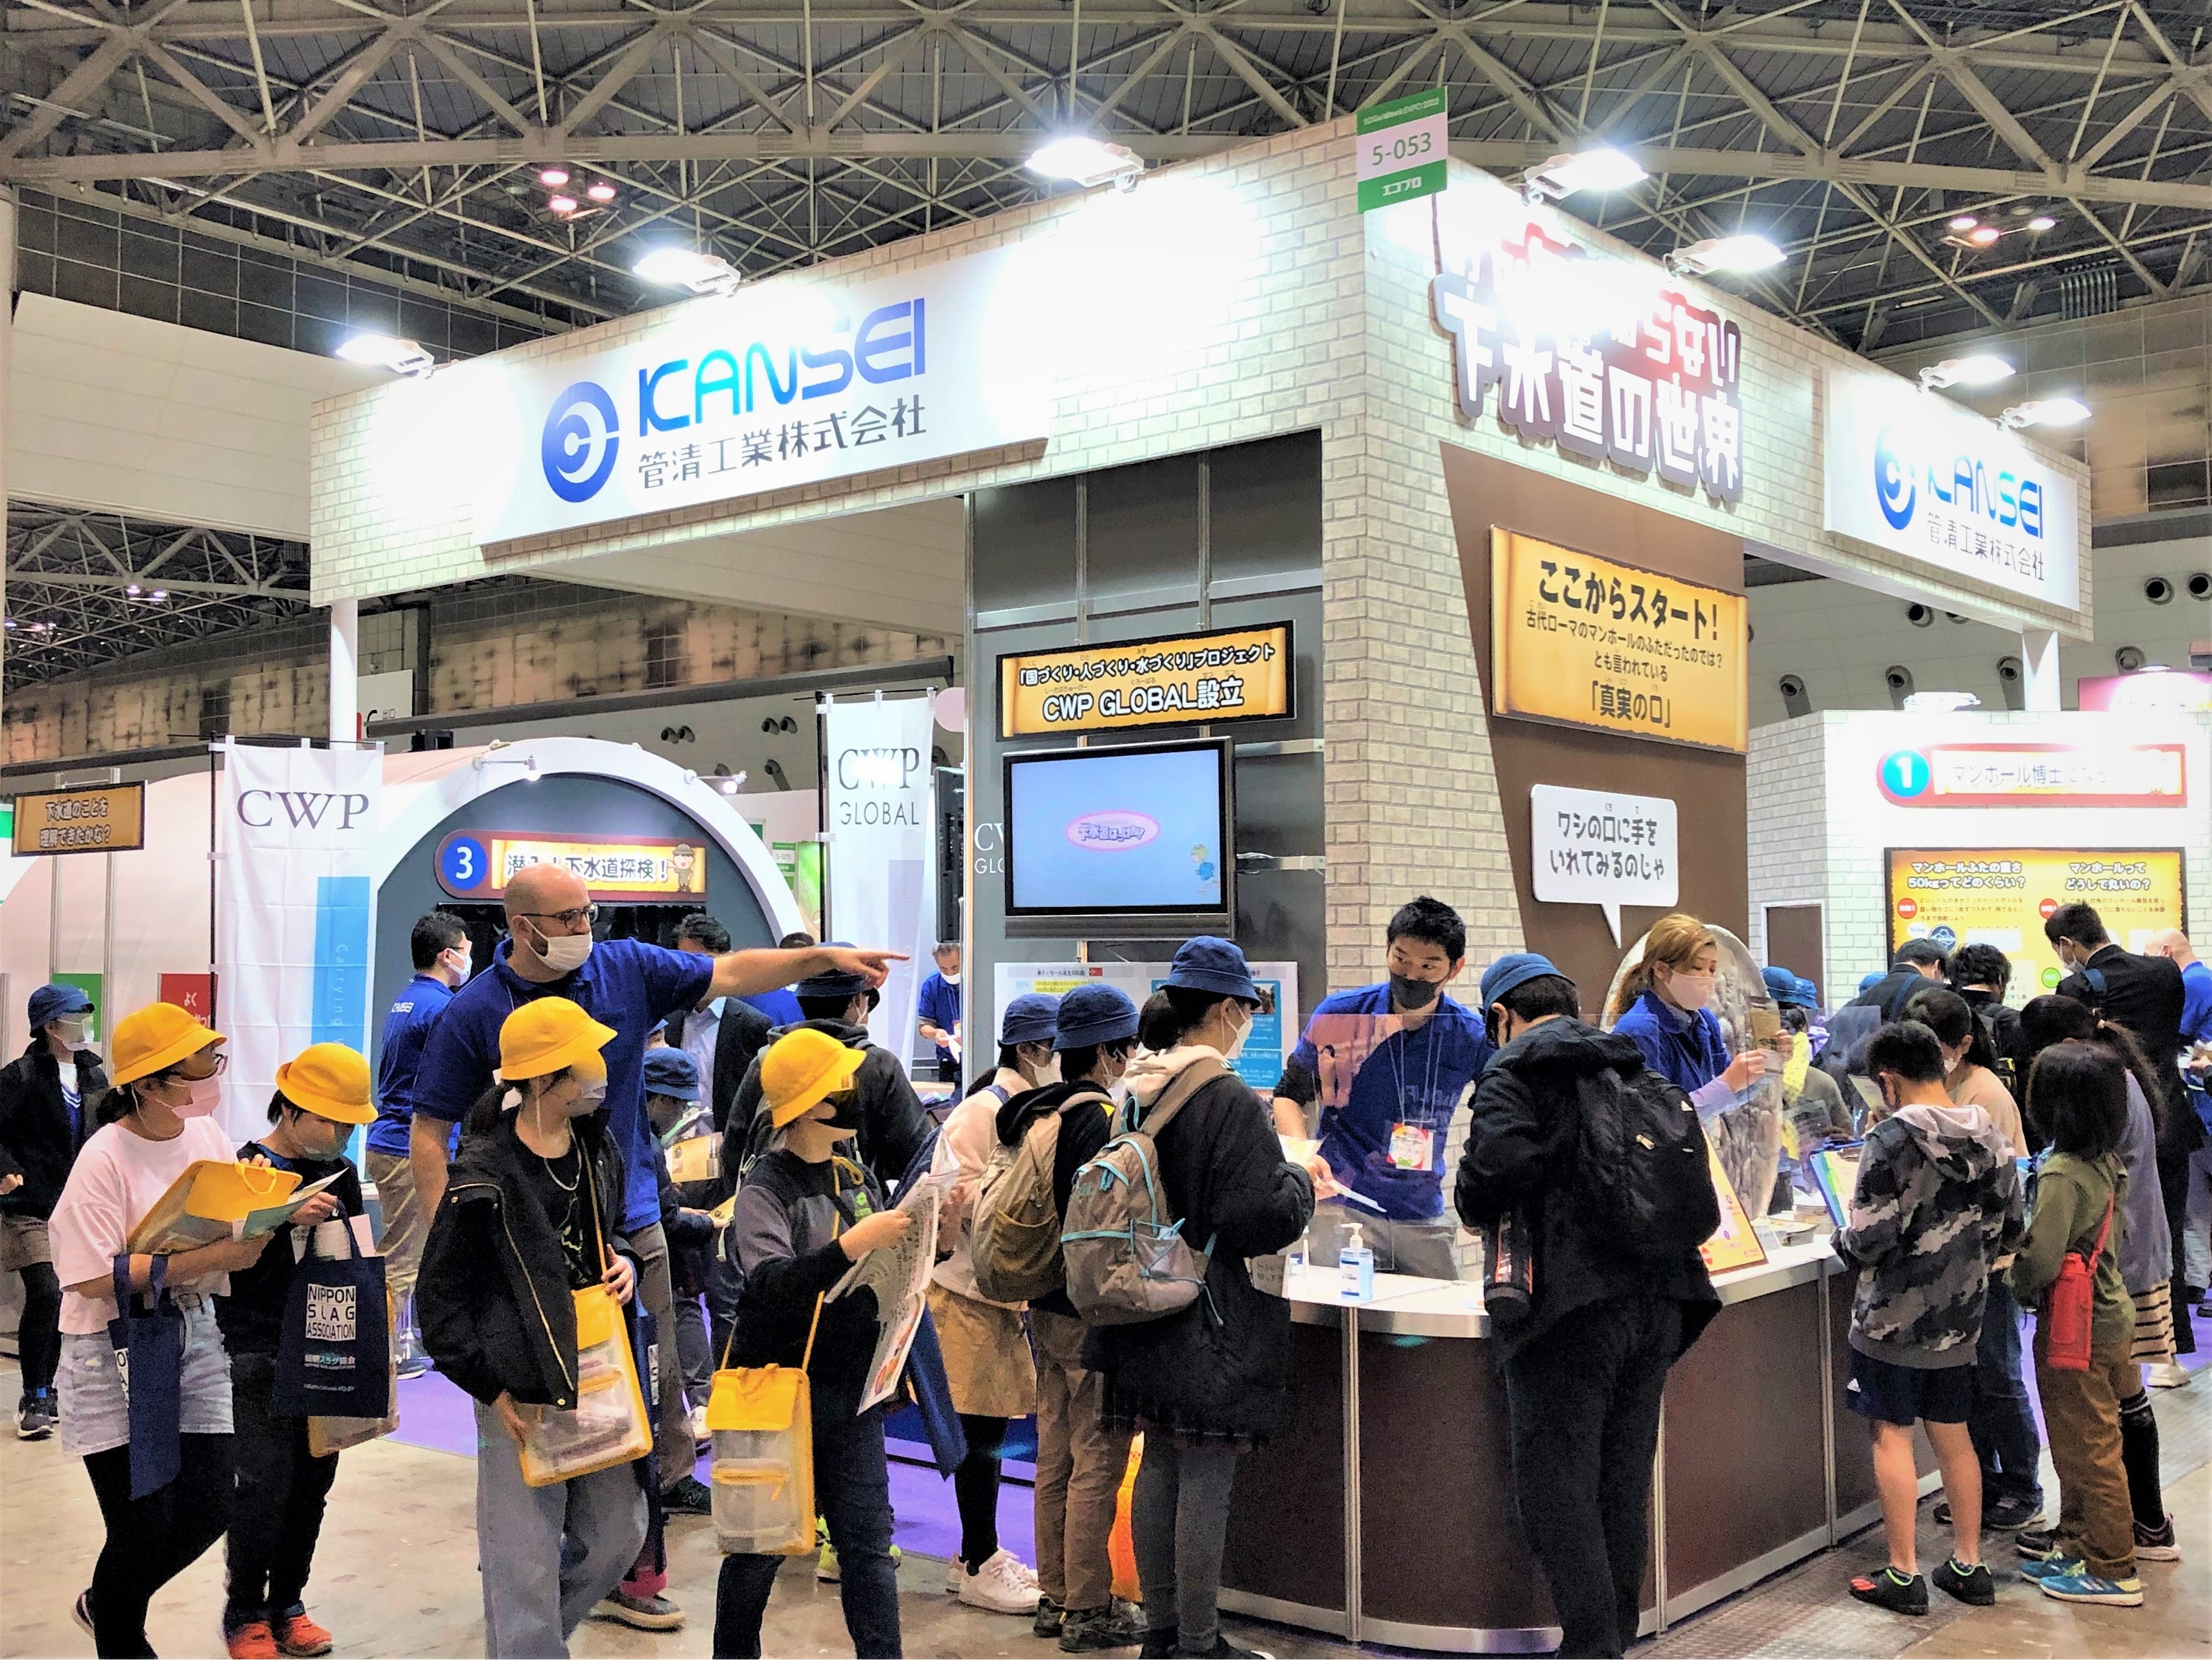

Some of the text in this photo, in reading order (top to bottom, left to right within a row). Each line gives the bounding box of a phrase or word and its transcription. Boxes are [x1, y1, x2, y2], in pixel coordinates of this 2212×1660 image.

[1373, 132, 1432, 166] 5-053
[639, 298, 925, 437] KANSEI
[638, 394, 927, 489] 管清工業株式会社
[1539, 559, 1718, 641] ここからスタート！
[1526, 608, 1722, 668] 古代ローマのマンホールのふただったのでは？
[1020, 642, 1274, 687] 「国づくり・人づくり・水づくり」プロジェクト
[1594, 651, 1667, 682] とも言われている
[1042, 677, 1244, 722] CWP GLOBAL設立
[1592, 681, 1670, 728] 「真実の口」
[1896, 757, 1912, 788] 1
[46, 796, 109, 821] 下水道のことを
[237, 789, 369, 830] CWP
[840, 801, 920, 825] GLOBAL
[40, 825, 111, 847] 理解できたかな？
[1558, 811, 1657, 846] ワシの口に手を
[455, 846, 474, 879] 3
[508, 855, 666, 880] 潜下水道探検！
[1550, 848, 1664, 881] いれてみるのじゃ
[2069, 861, 2147, 875] マンホールって
[2065, 877, 2151, 891] どうして丸いの？
[331, 944, 348, 1027] Carrying
[308, 1285, 354, 1303] NIPPON
[307, 1304, 354, 1321] SLAG
[307, 1322, 354, 1340] ASSOCIATION
